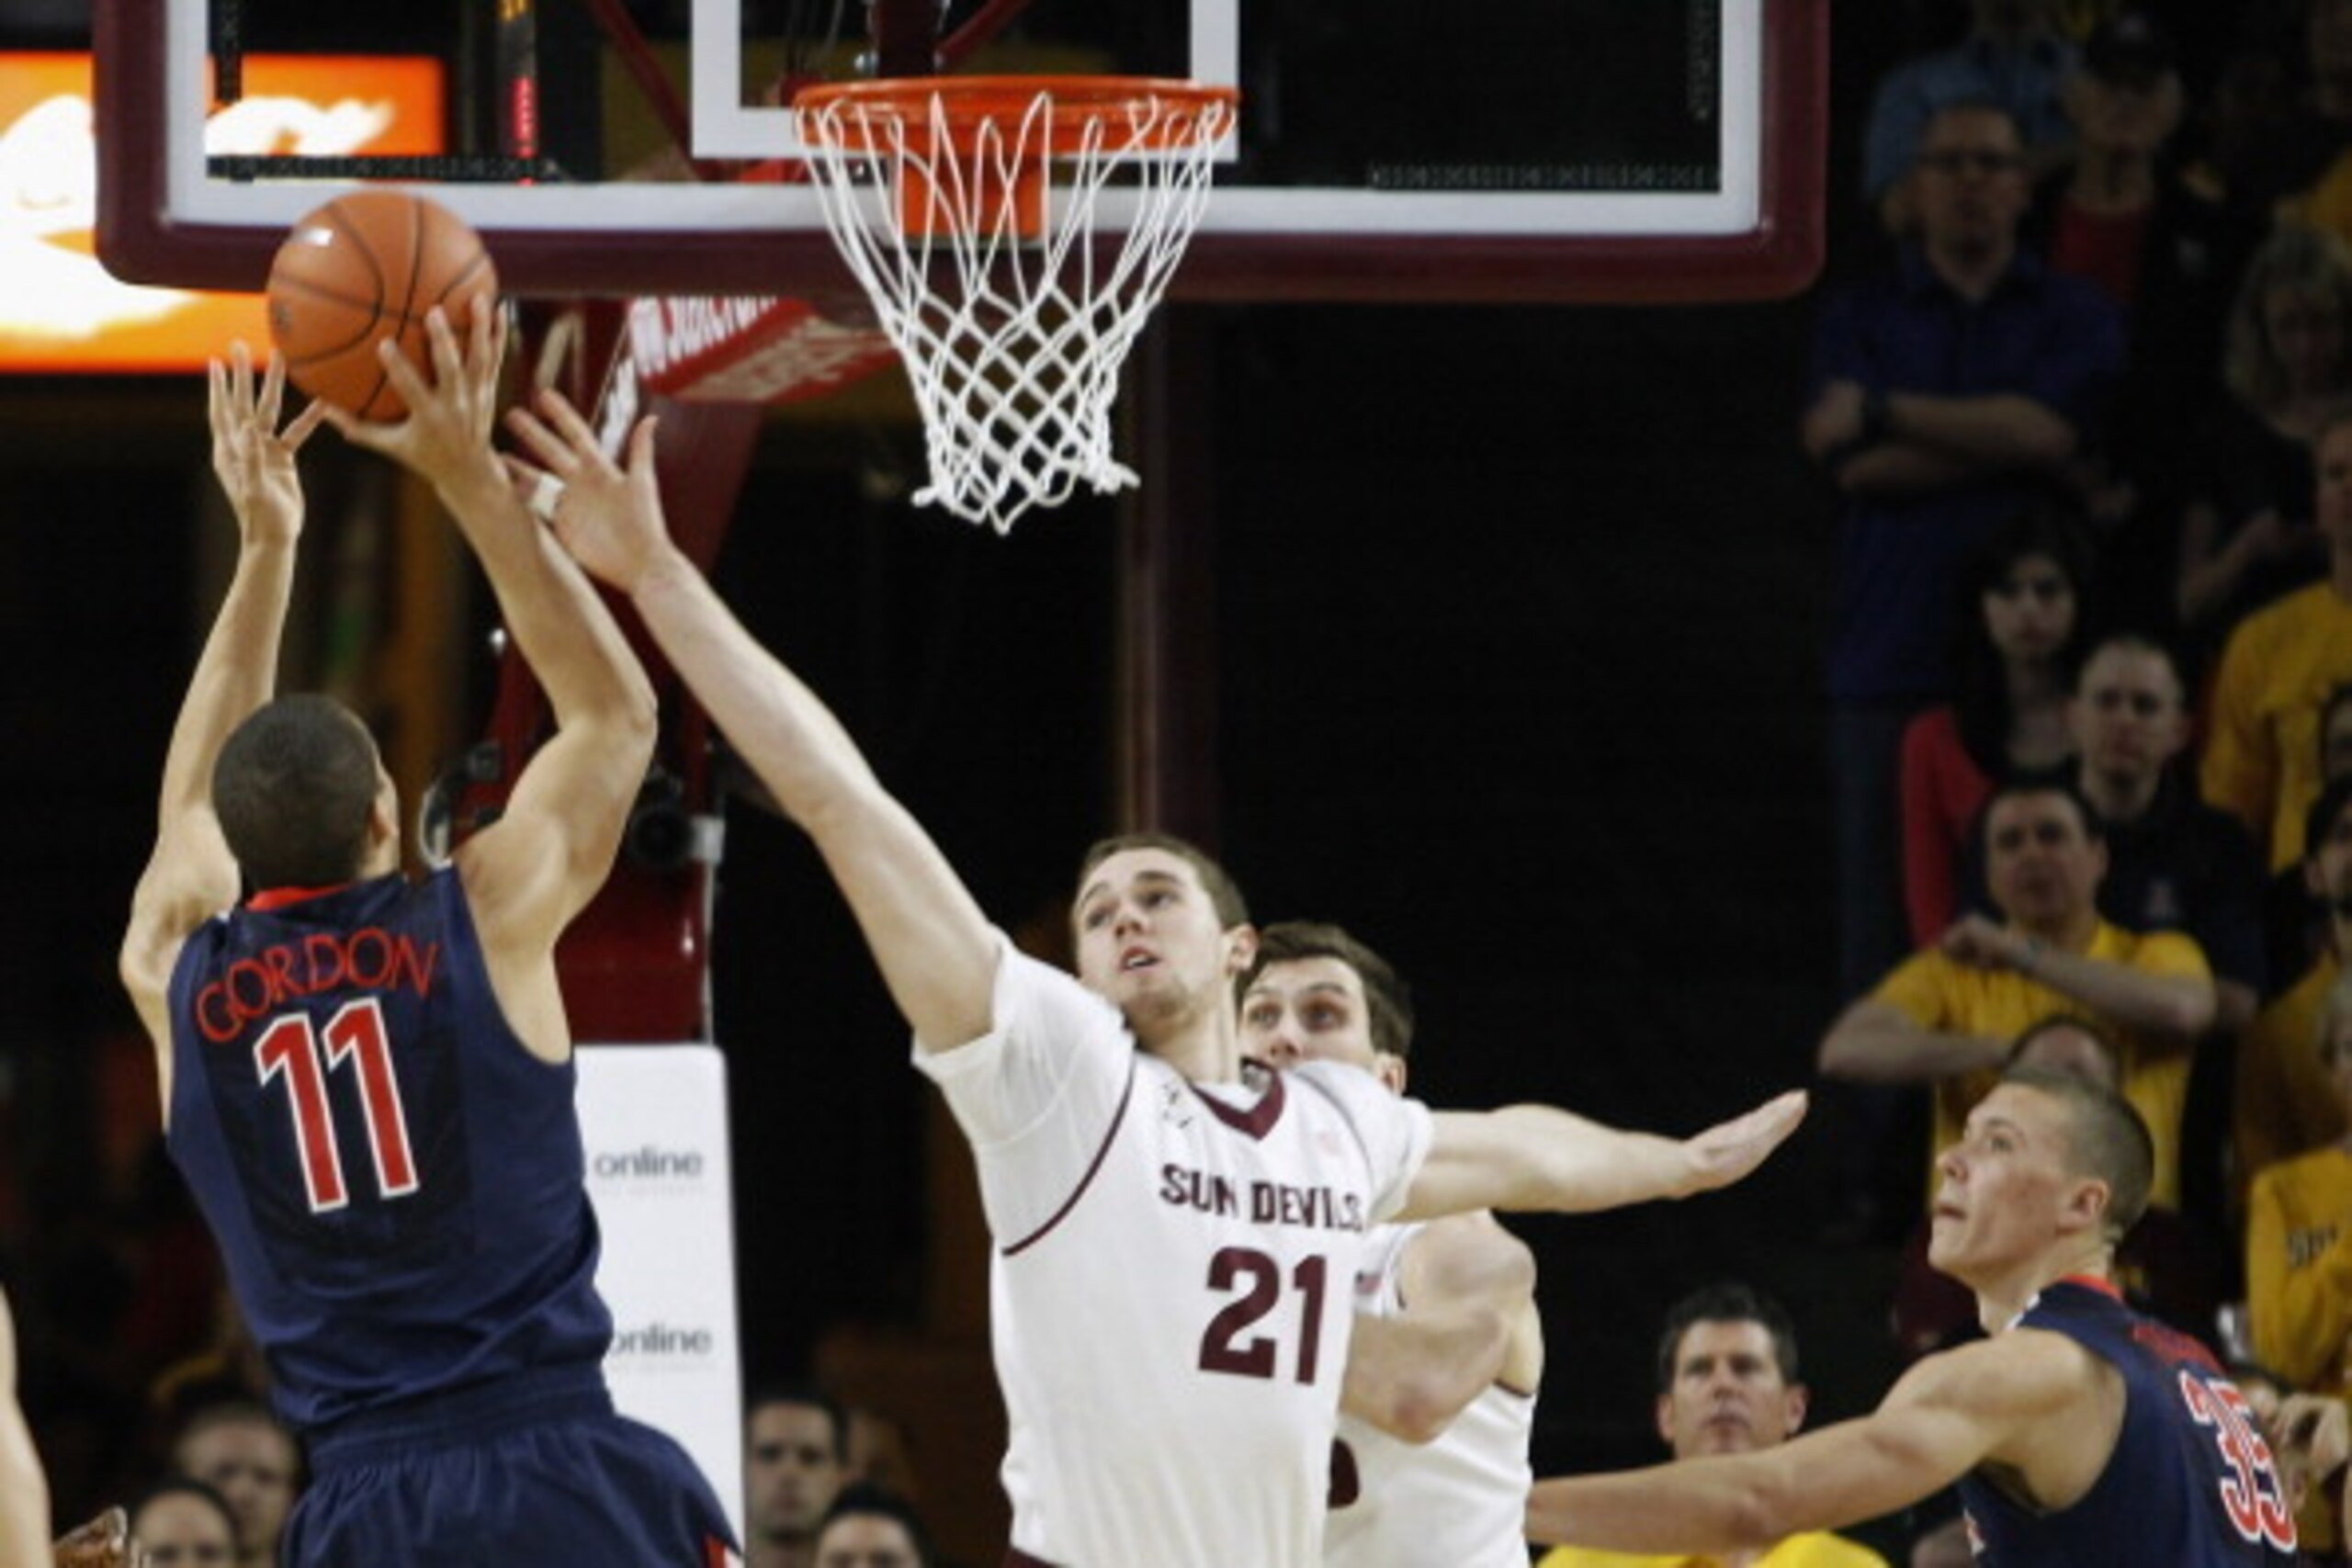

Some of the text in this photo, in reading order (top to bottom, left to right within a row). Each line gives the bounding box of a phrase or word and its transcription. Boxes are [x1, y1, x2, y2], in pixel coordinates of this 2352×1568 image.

[196, 927, 438, 1042] GORDON
[253, 996, 419, 1213] 11
[595, 1145, 704, 1178] online
[1159, 1163, 1363, 1232] SUN DEVILS
[1199, 1247, 1327, 1385] 21
[2178, 1370, 2297, 1553] 35
